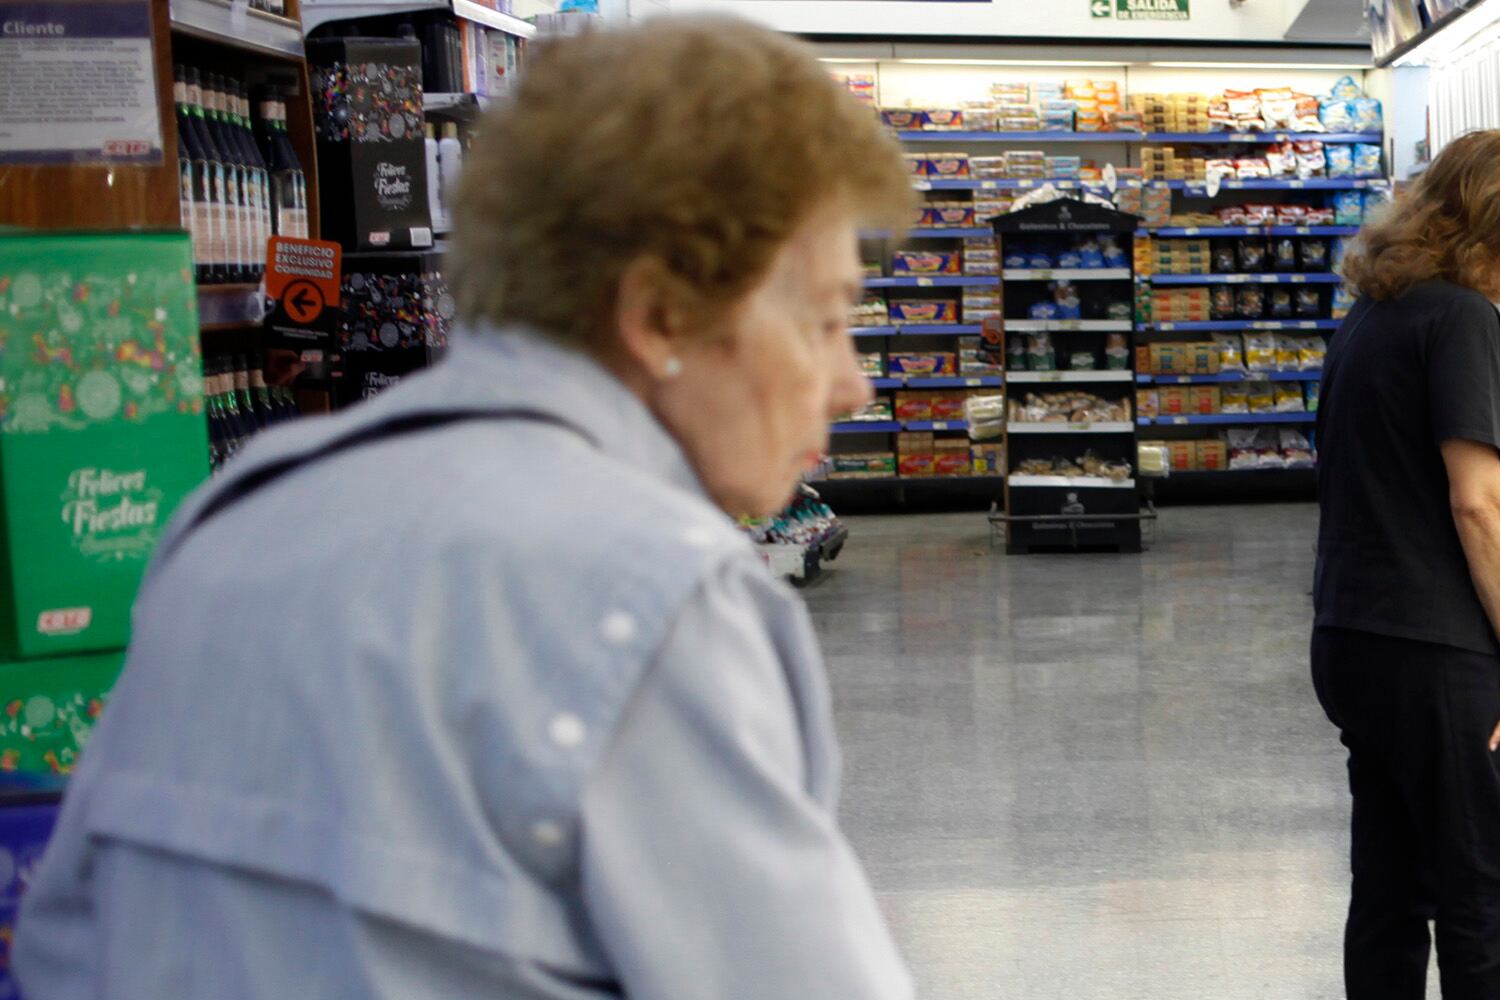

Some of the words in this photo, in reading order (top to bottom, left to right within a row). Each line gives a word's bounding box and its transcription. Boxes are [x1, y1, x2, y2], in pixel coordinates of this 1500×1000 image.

[3, 22, 65, 34] Cliente
[276, 242, 335, 258] BENEFICIO
[275, 254, 333, 268] EXCLUSIVO
[274, 265, 333, 279] COMUNIDAD
